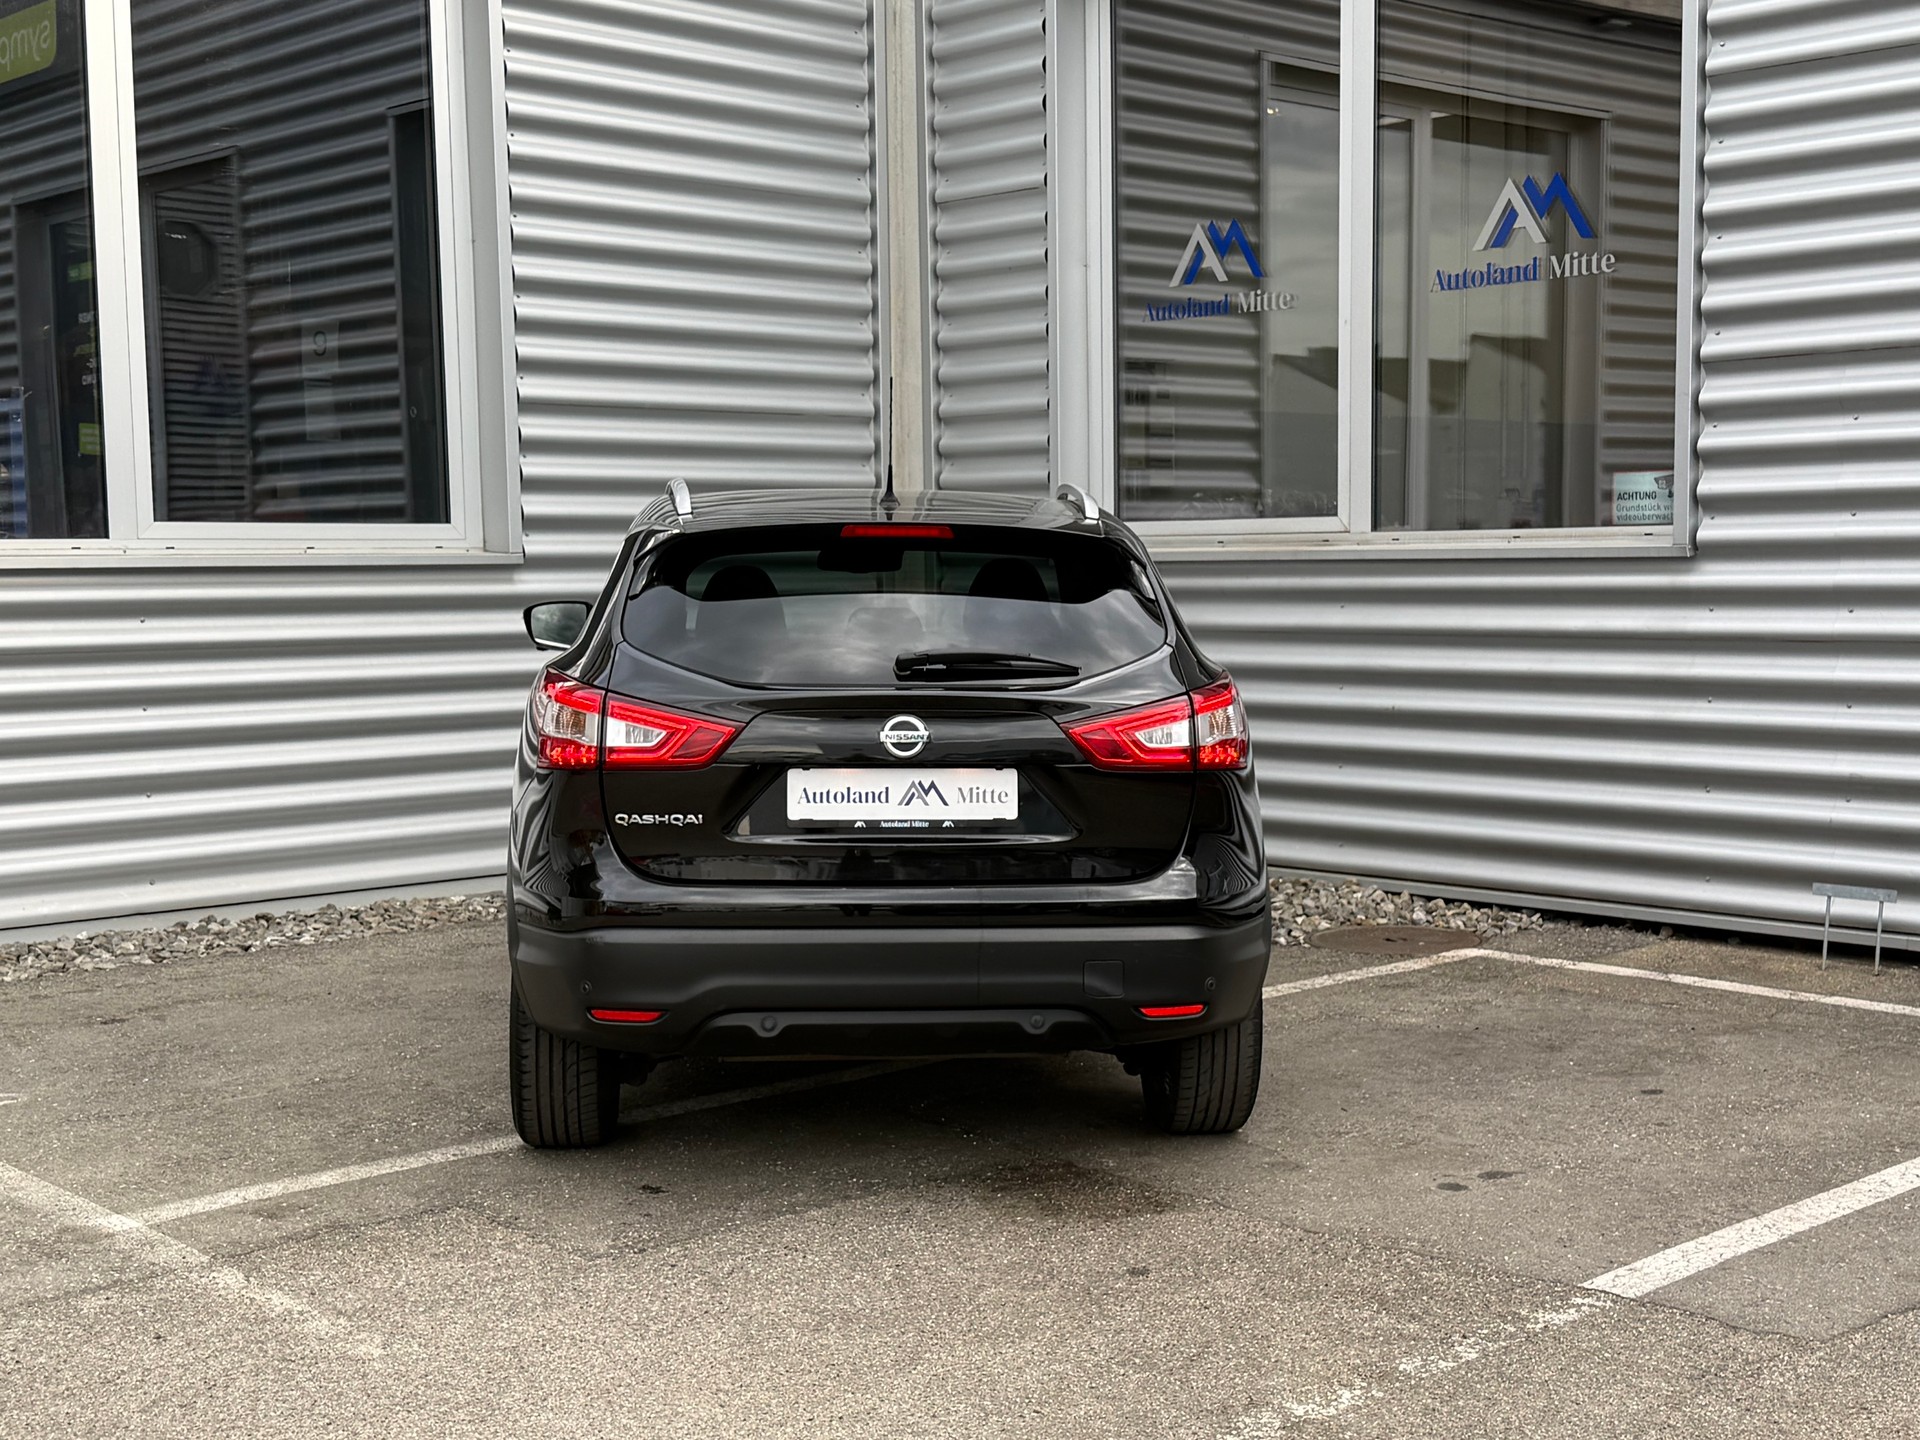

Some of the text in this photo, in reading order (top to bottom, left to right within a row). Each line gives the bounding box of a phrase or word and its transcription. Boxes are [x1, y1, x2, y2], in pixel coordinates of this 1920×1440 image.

[1430, 251, 1616, 293] Autoland Mitte
[1142, 289, 1291, 323] Autoland Mitte
[1617, 491, 1657, 501] ACHTUNG
[1616, 503, 1661, 512] Grundstück
[797, 786, 889, 804] Autoland
[957, 786, 1009, 805] Mitte
[614, 813, 703, 827] QASHQAI
[880, 820, 930, 828] Autoland Mitte
